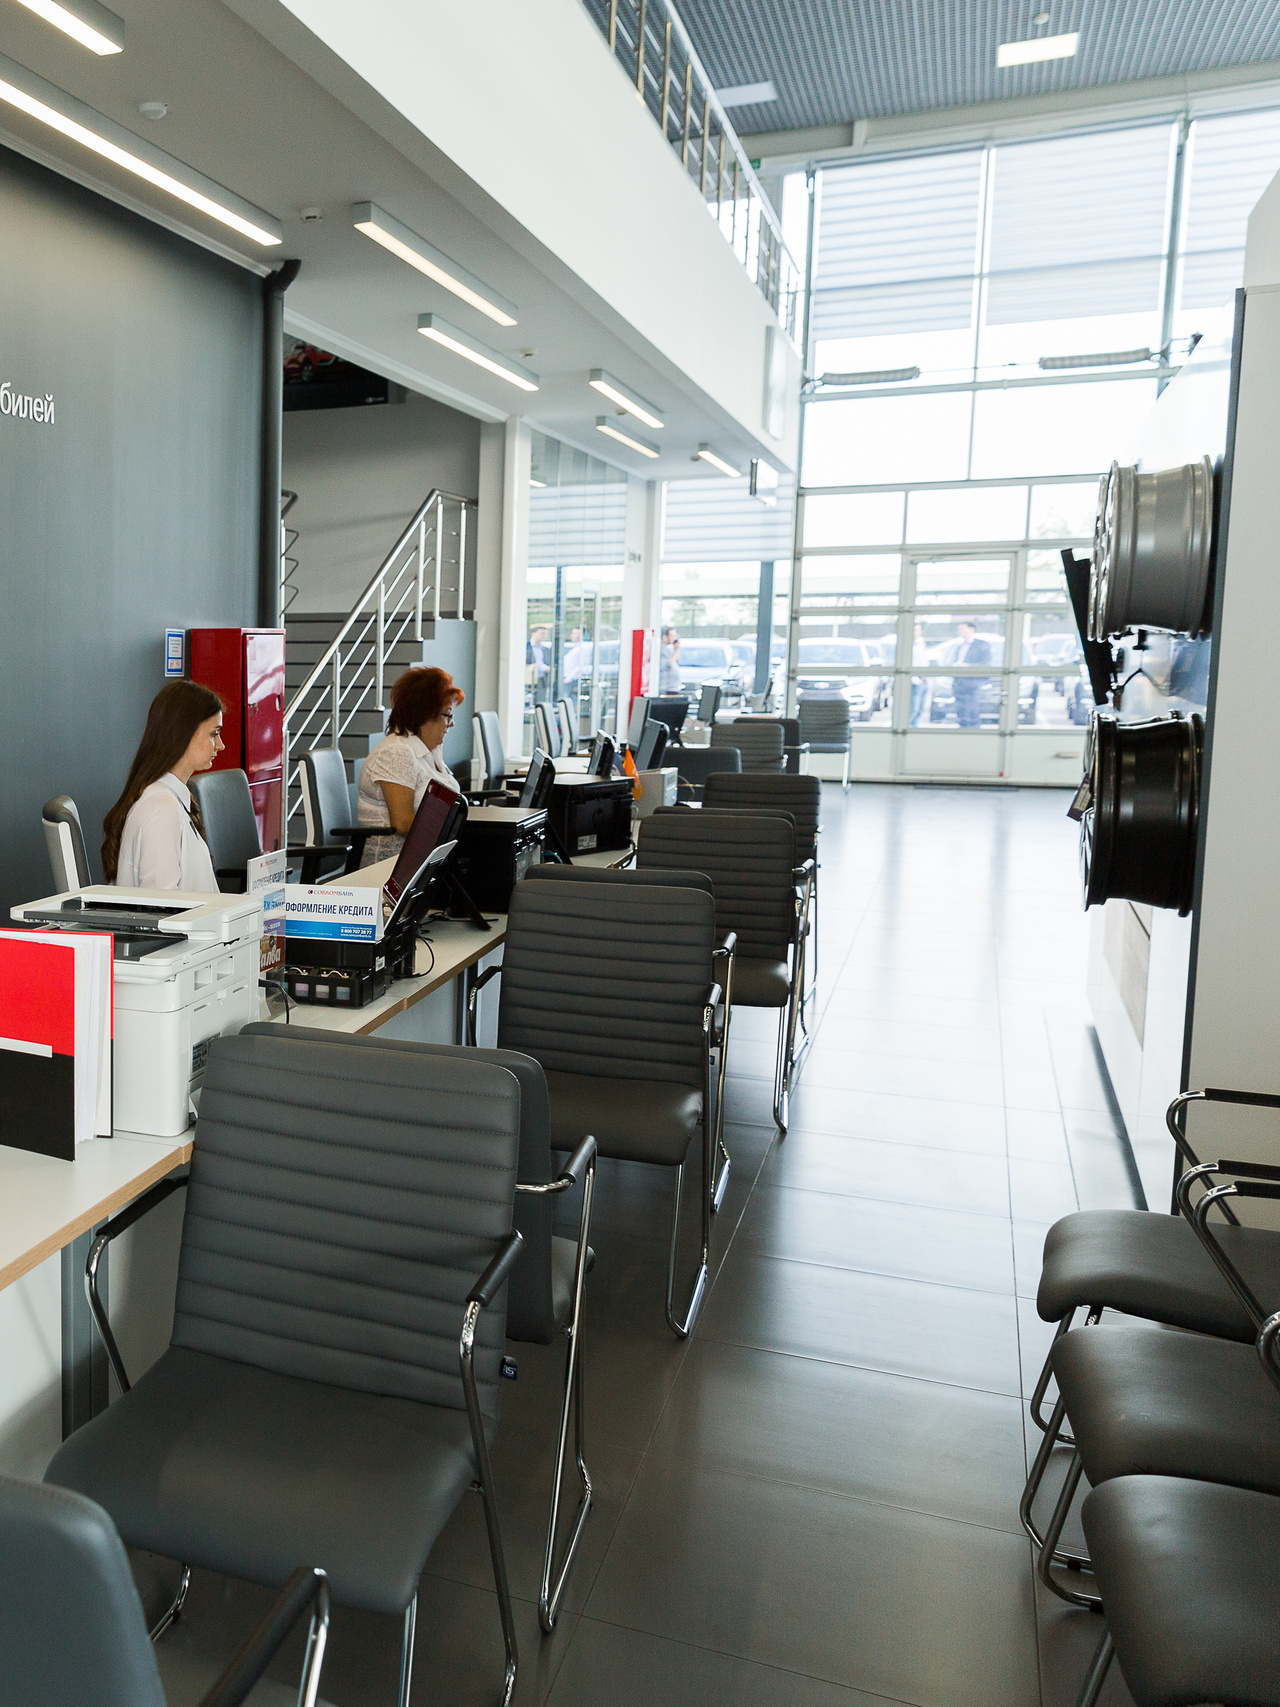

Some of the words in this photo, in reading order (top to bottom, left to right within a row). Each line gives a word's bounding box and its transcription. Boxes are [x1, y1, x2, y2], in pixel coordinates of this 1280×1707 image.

[285, 902, 337, 915] ОФОРМЛЕНИЕ
[338, 904, 374, 917] КРЕДИТА
[260, 944, 281, 968] алва
